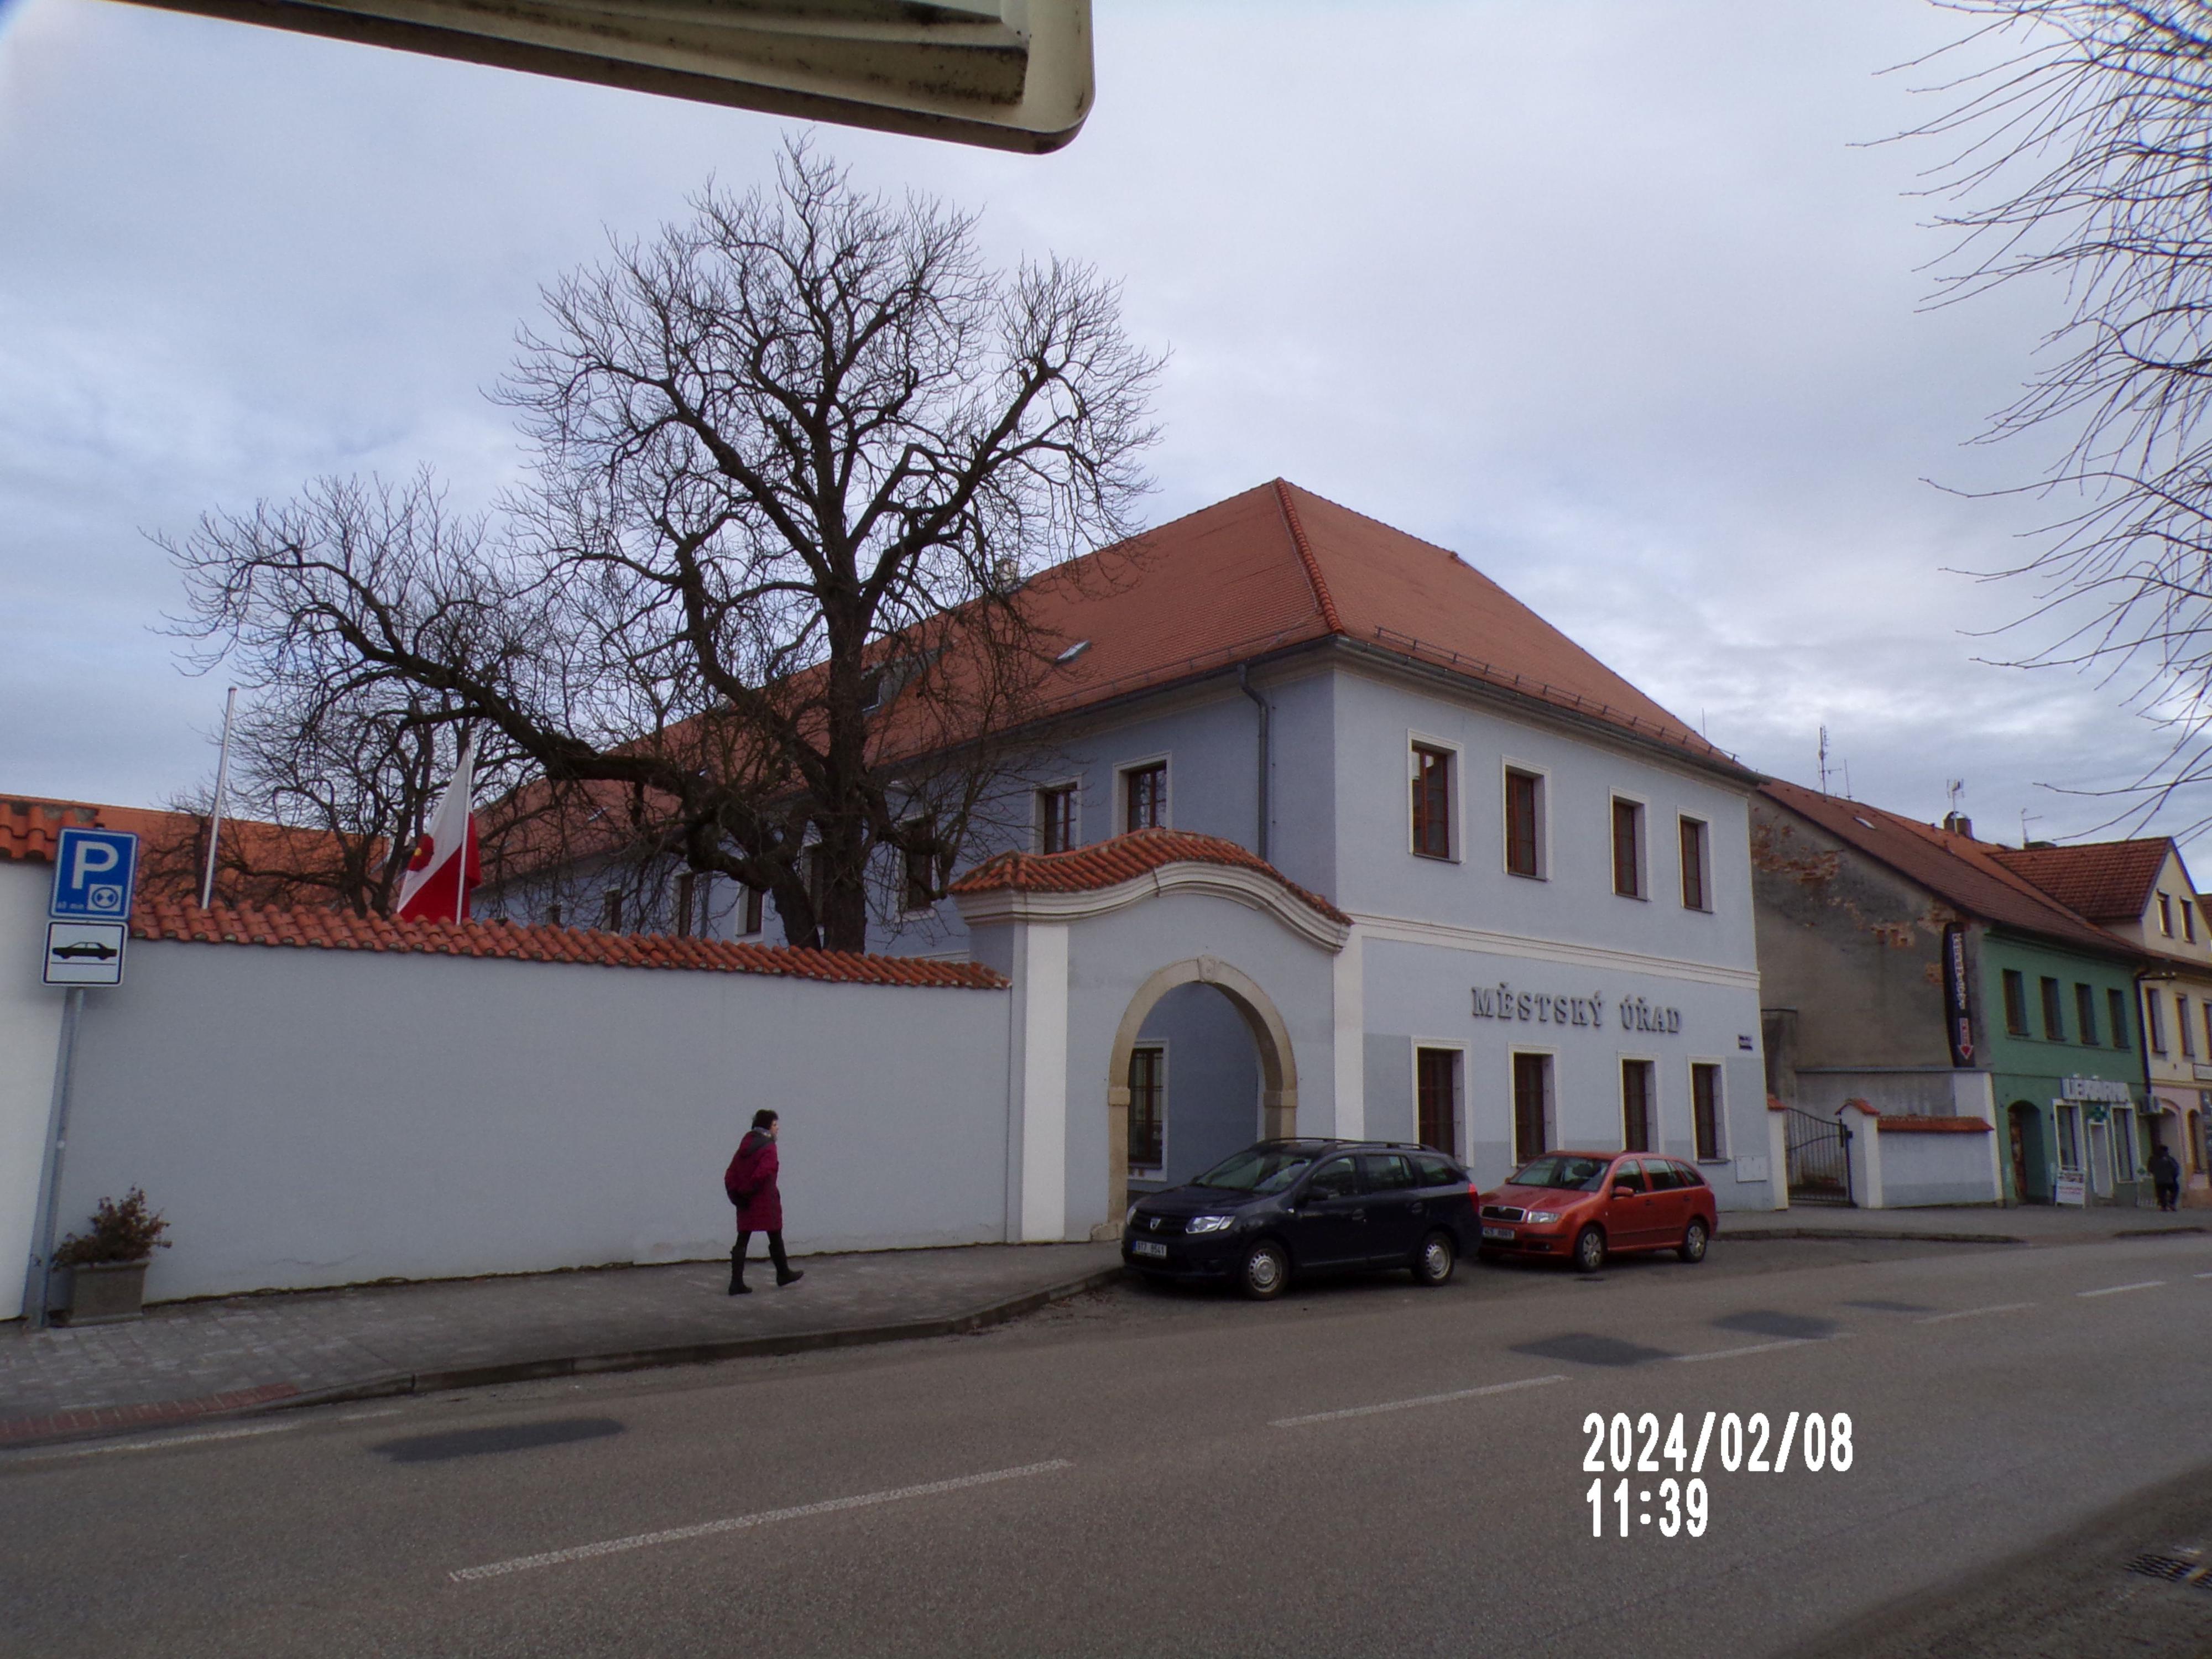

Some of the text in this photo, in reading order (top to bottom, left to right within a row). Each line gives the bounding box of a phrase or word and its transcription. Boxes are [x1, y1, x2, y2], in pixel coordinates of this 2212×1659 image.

[71, 840, 119, 889] P
[1472, 982, 1683, 1034] MĚSTSKÝ ÚŘAD
